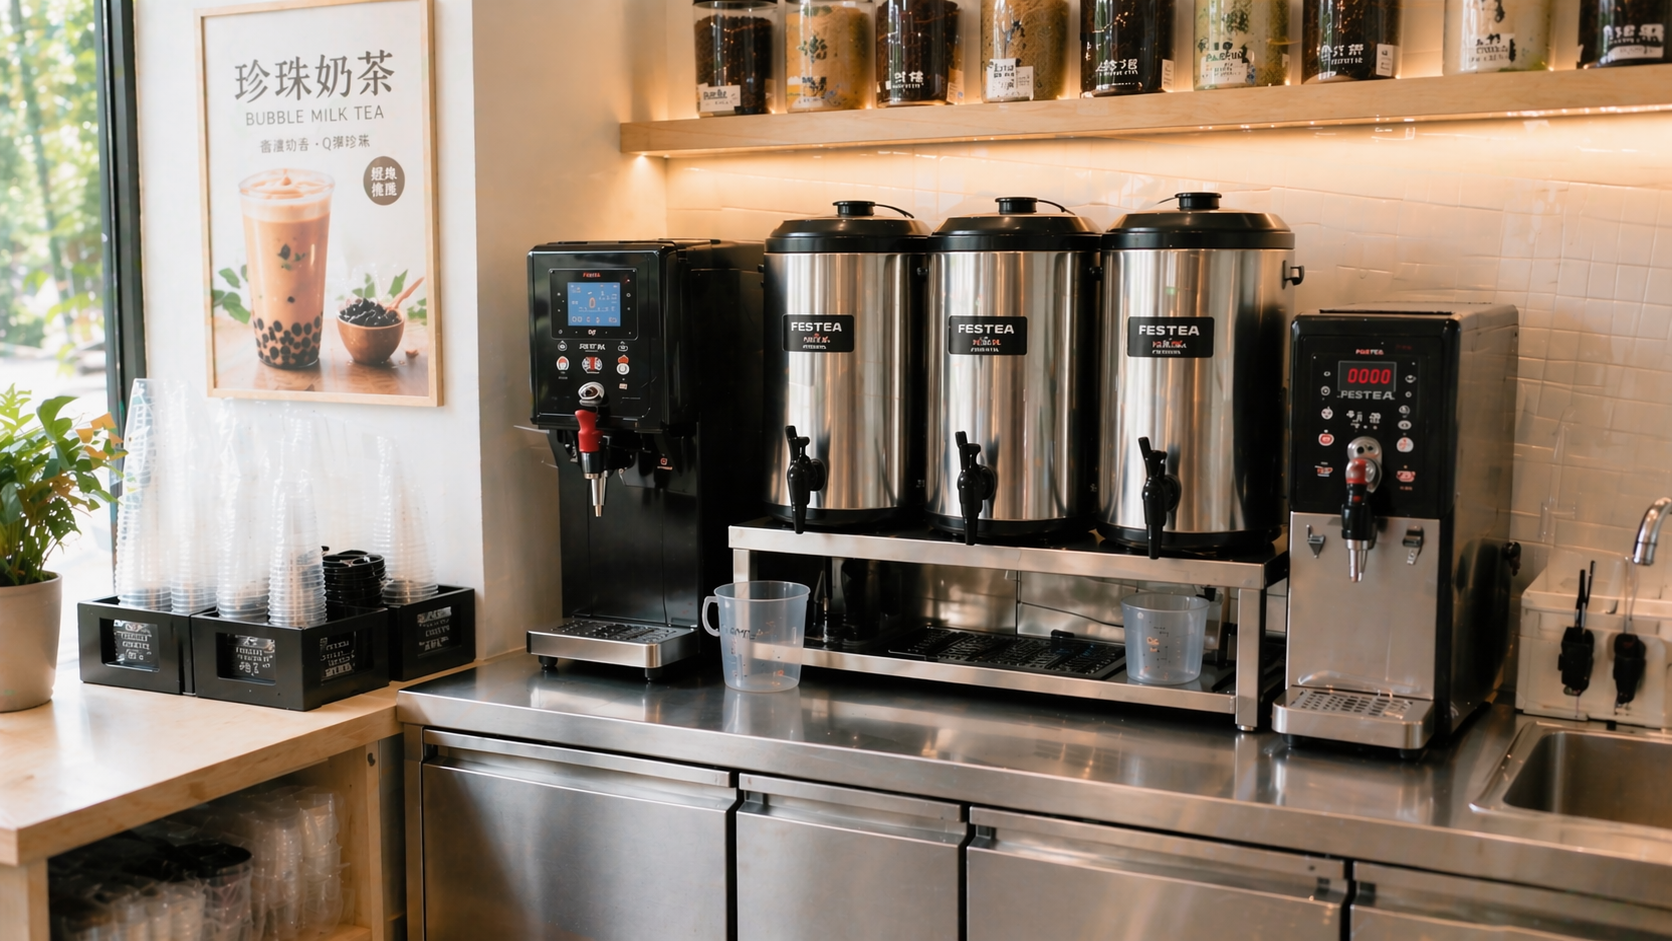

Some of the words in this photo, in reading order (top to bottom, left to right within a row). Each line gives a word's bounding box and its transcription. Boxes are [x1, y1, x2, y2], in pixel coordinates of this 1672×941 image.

[234, 49, 395, 104] 珍珠奶茶
[245, 110, 304, 126] BUBBLE
[311, 107, 348, 123] MILK
[354, 104, 384, 120] TEA
[790, 322, 842, 332] FESTEA
[958, 324, 1015, 334] FESTEA
[1138, 325, 1200, 336] FESTEA
[1347, 368, 1392, 384] 0000
